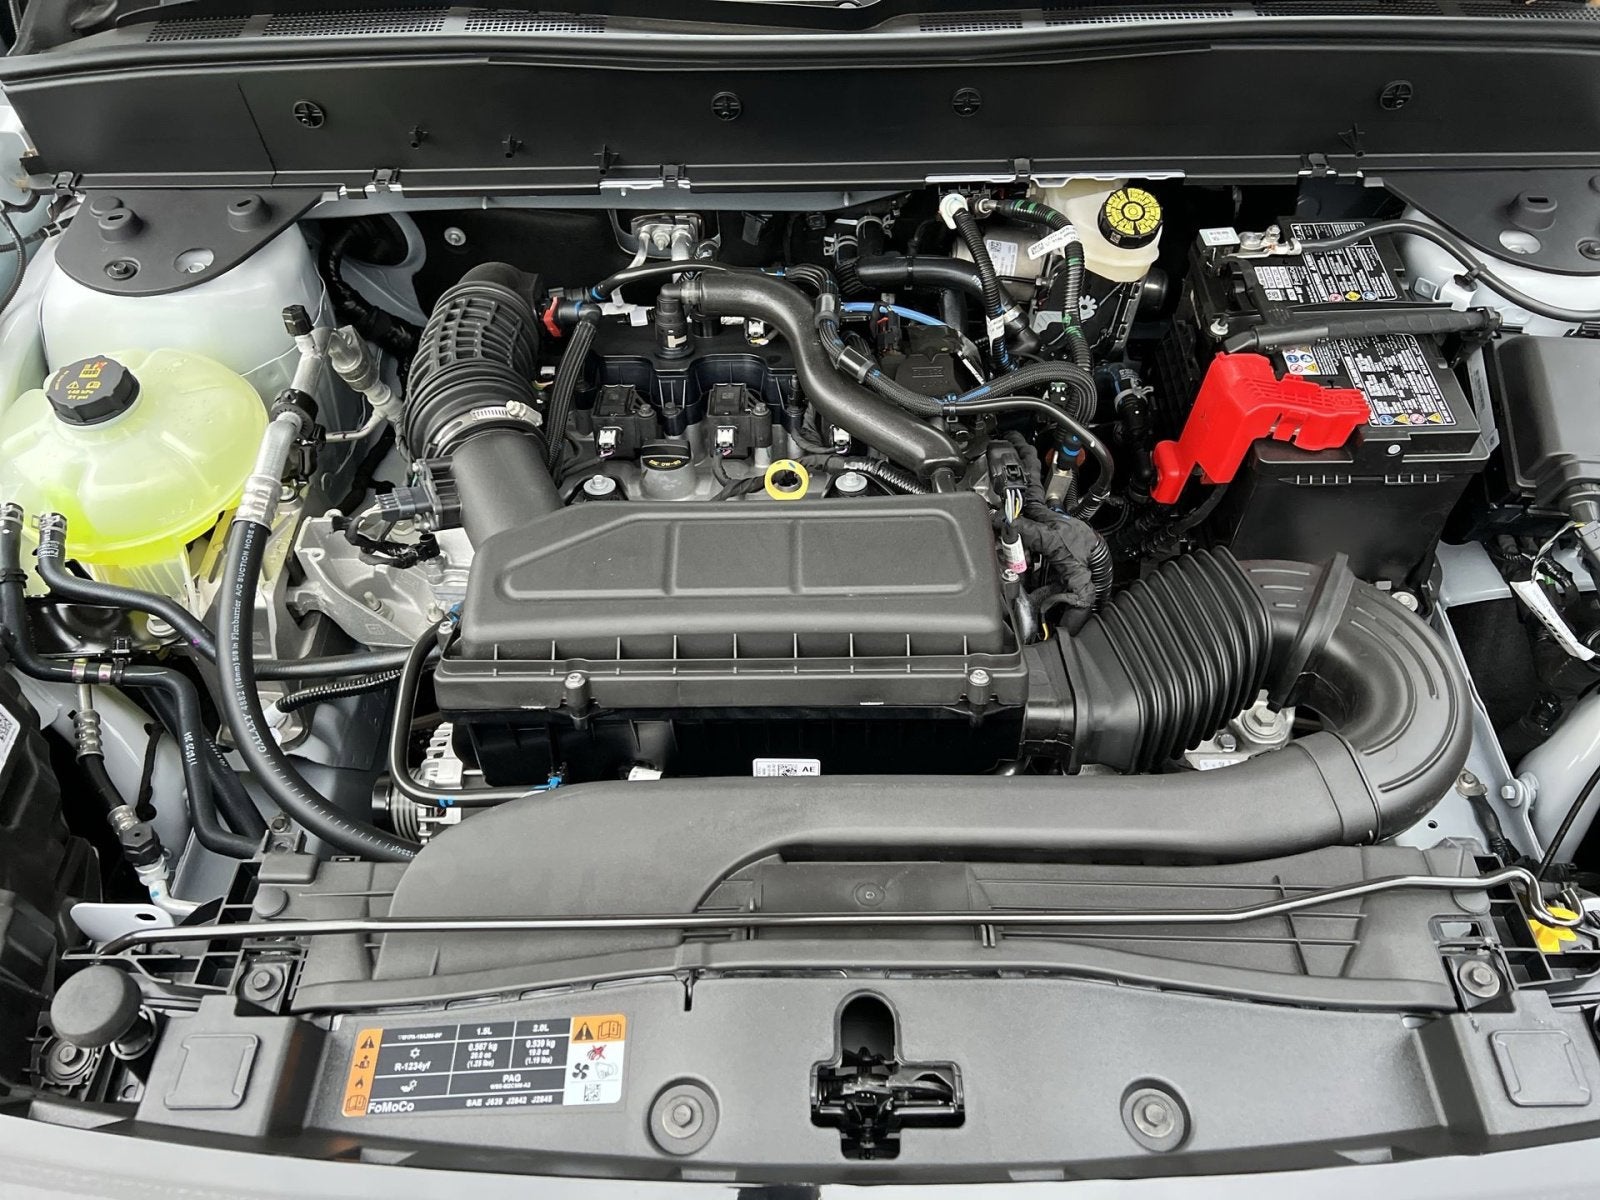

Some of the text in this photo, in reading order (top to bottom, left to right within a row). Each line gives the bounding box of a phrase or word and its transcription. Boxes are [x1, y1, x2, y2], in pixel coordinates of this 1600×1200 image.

[244, 530, 255, 550] HOSE
[238, 550, 250, 582] SUCTION
[231, 600, 242, 641] Flexbarrier
[243, 714, 267, 753] GALAXY
[476, 1023, 550, 1036] 1.5L 2.0L
[468, 1042, 498, 1052] 0.567 kg
[546, 1039, 556, 1050] kg
[394, 1060, 430, 1072] R-1234yf
[502, 1074, 522, 1083] PAG
[367, 1101, 414, 1114] FoMoCo
[466, 1098, 482, 1108] SAE
